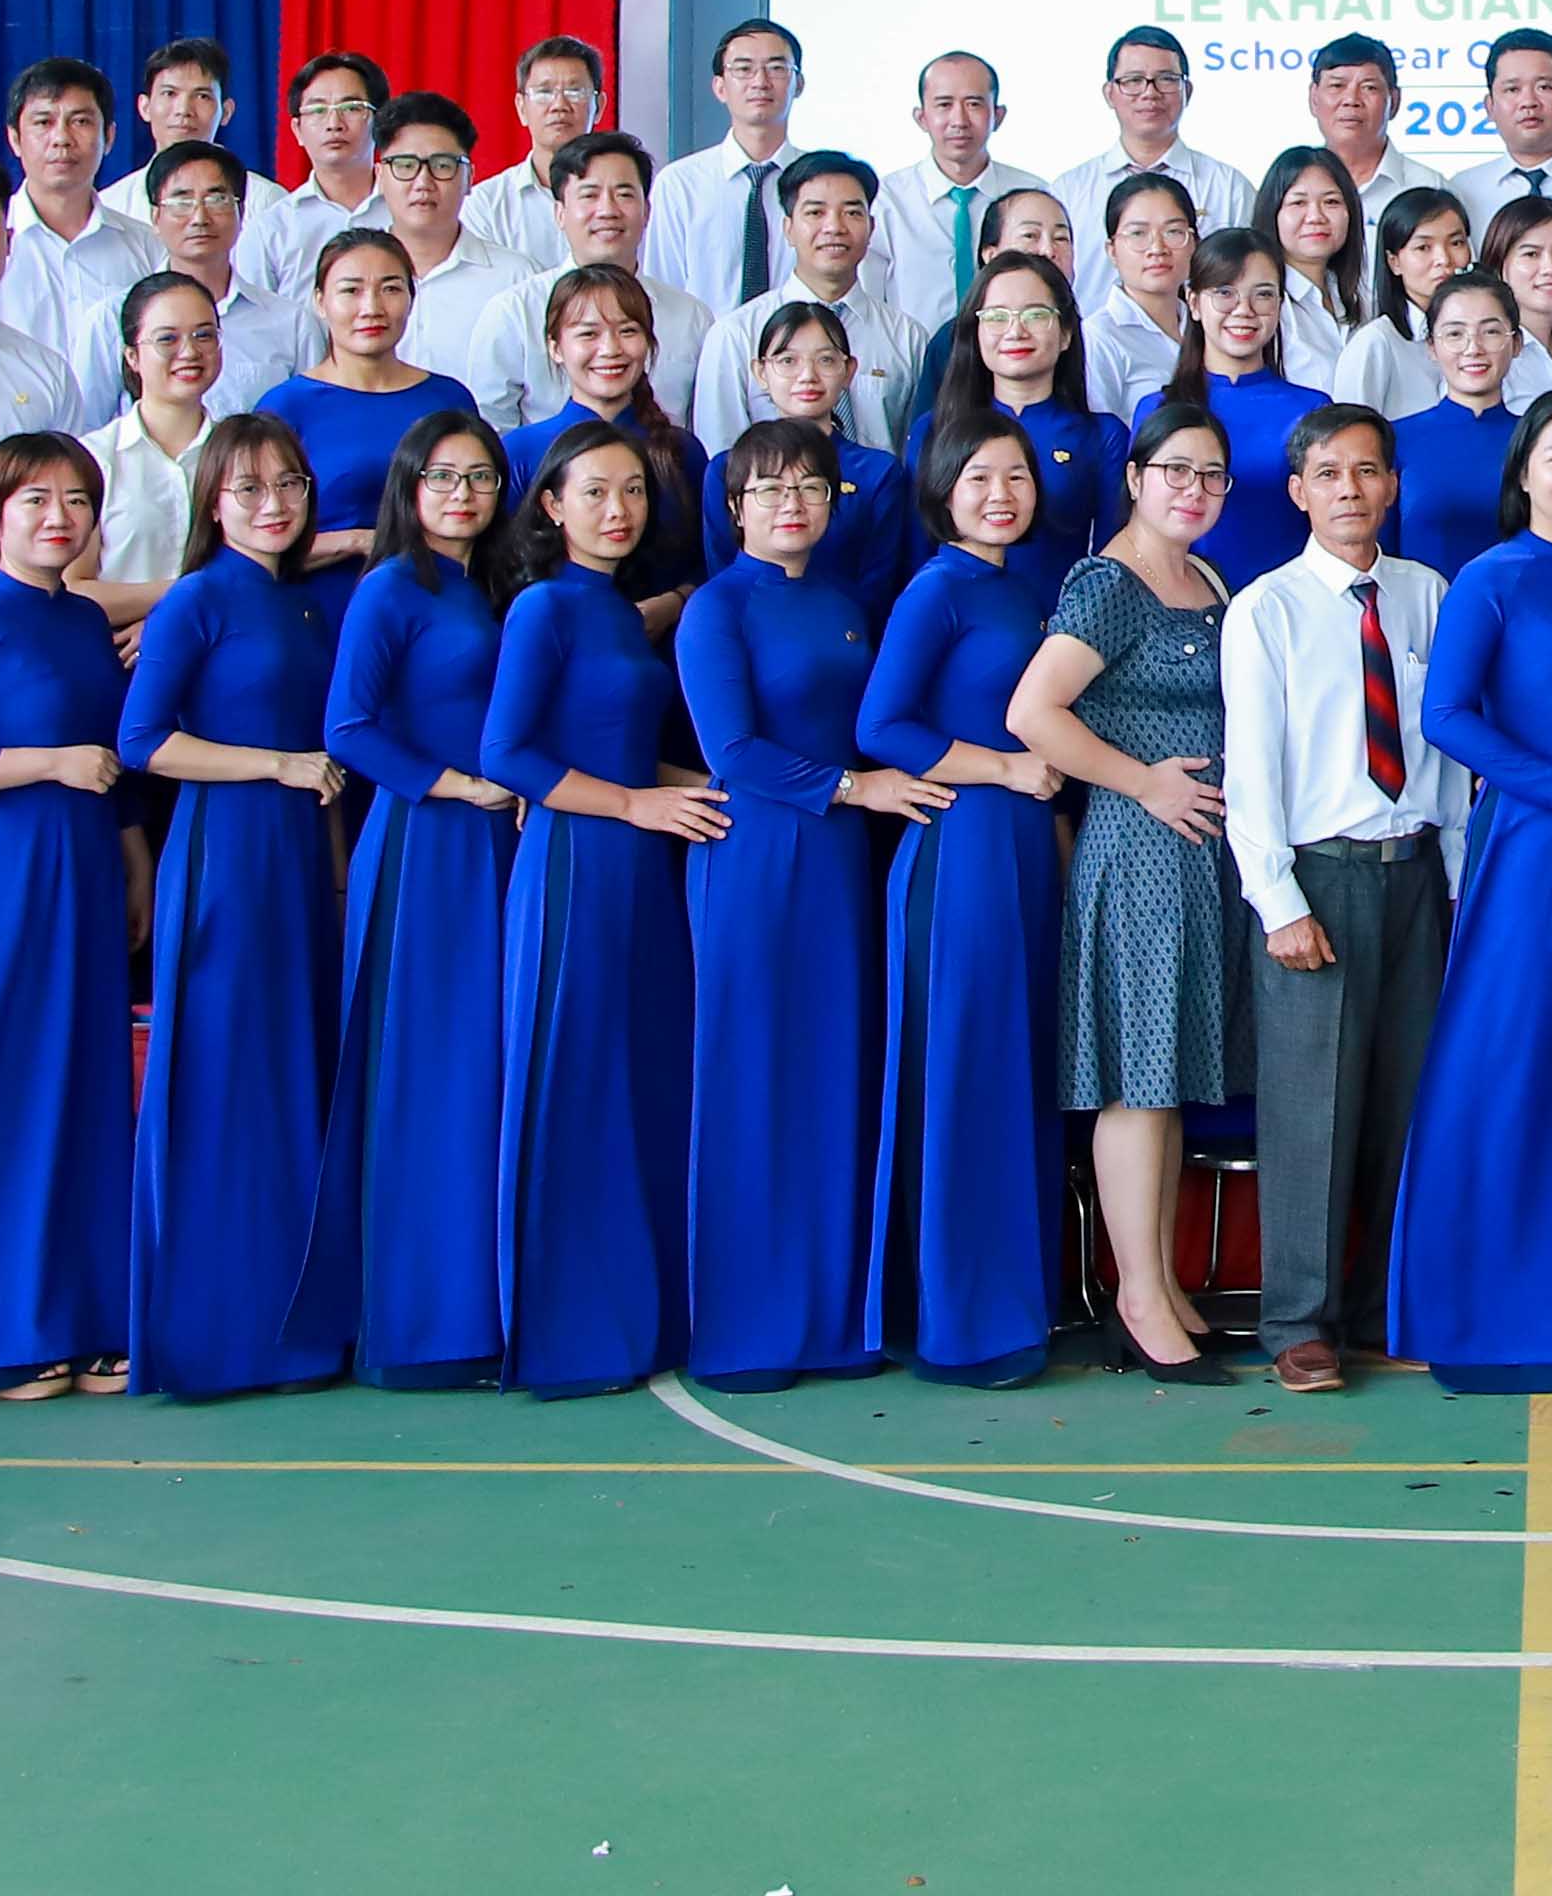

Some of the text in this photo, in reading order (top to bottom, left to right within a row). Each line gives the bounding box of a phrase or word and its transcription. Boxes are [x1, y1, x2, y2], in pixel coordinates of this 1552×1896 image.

[1204, 41, 1320, 71] Scho
[1389, 47, 1451, 70] ear
[1405, 100, 1499, 136] 202
